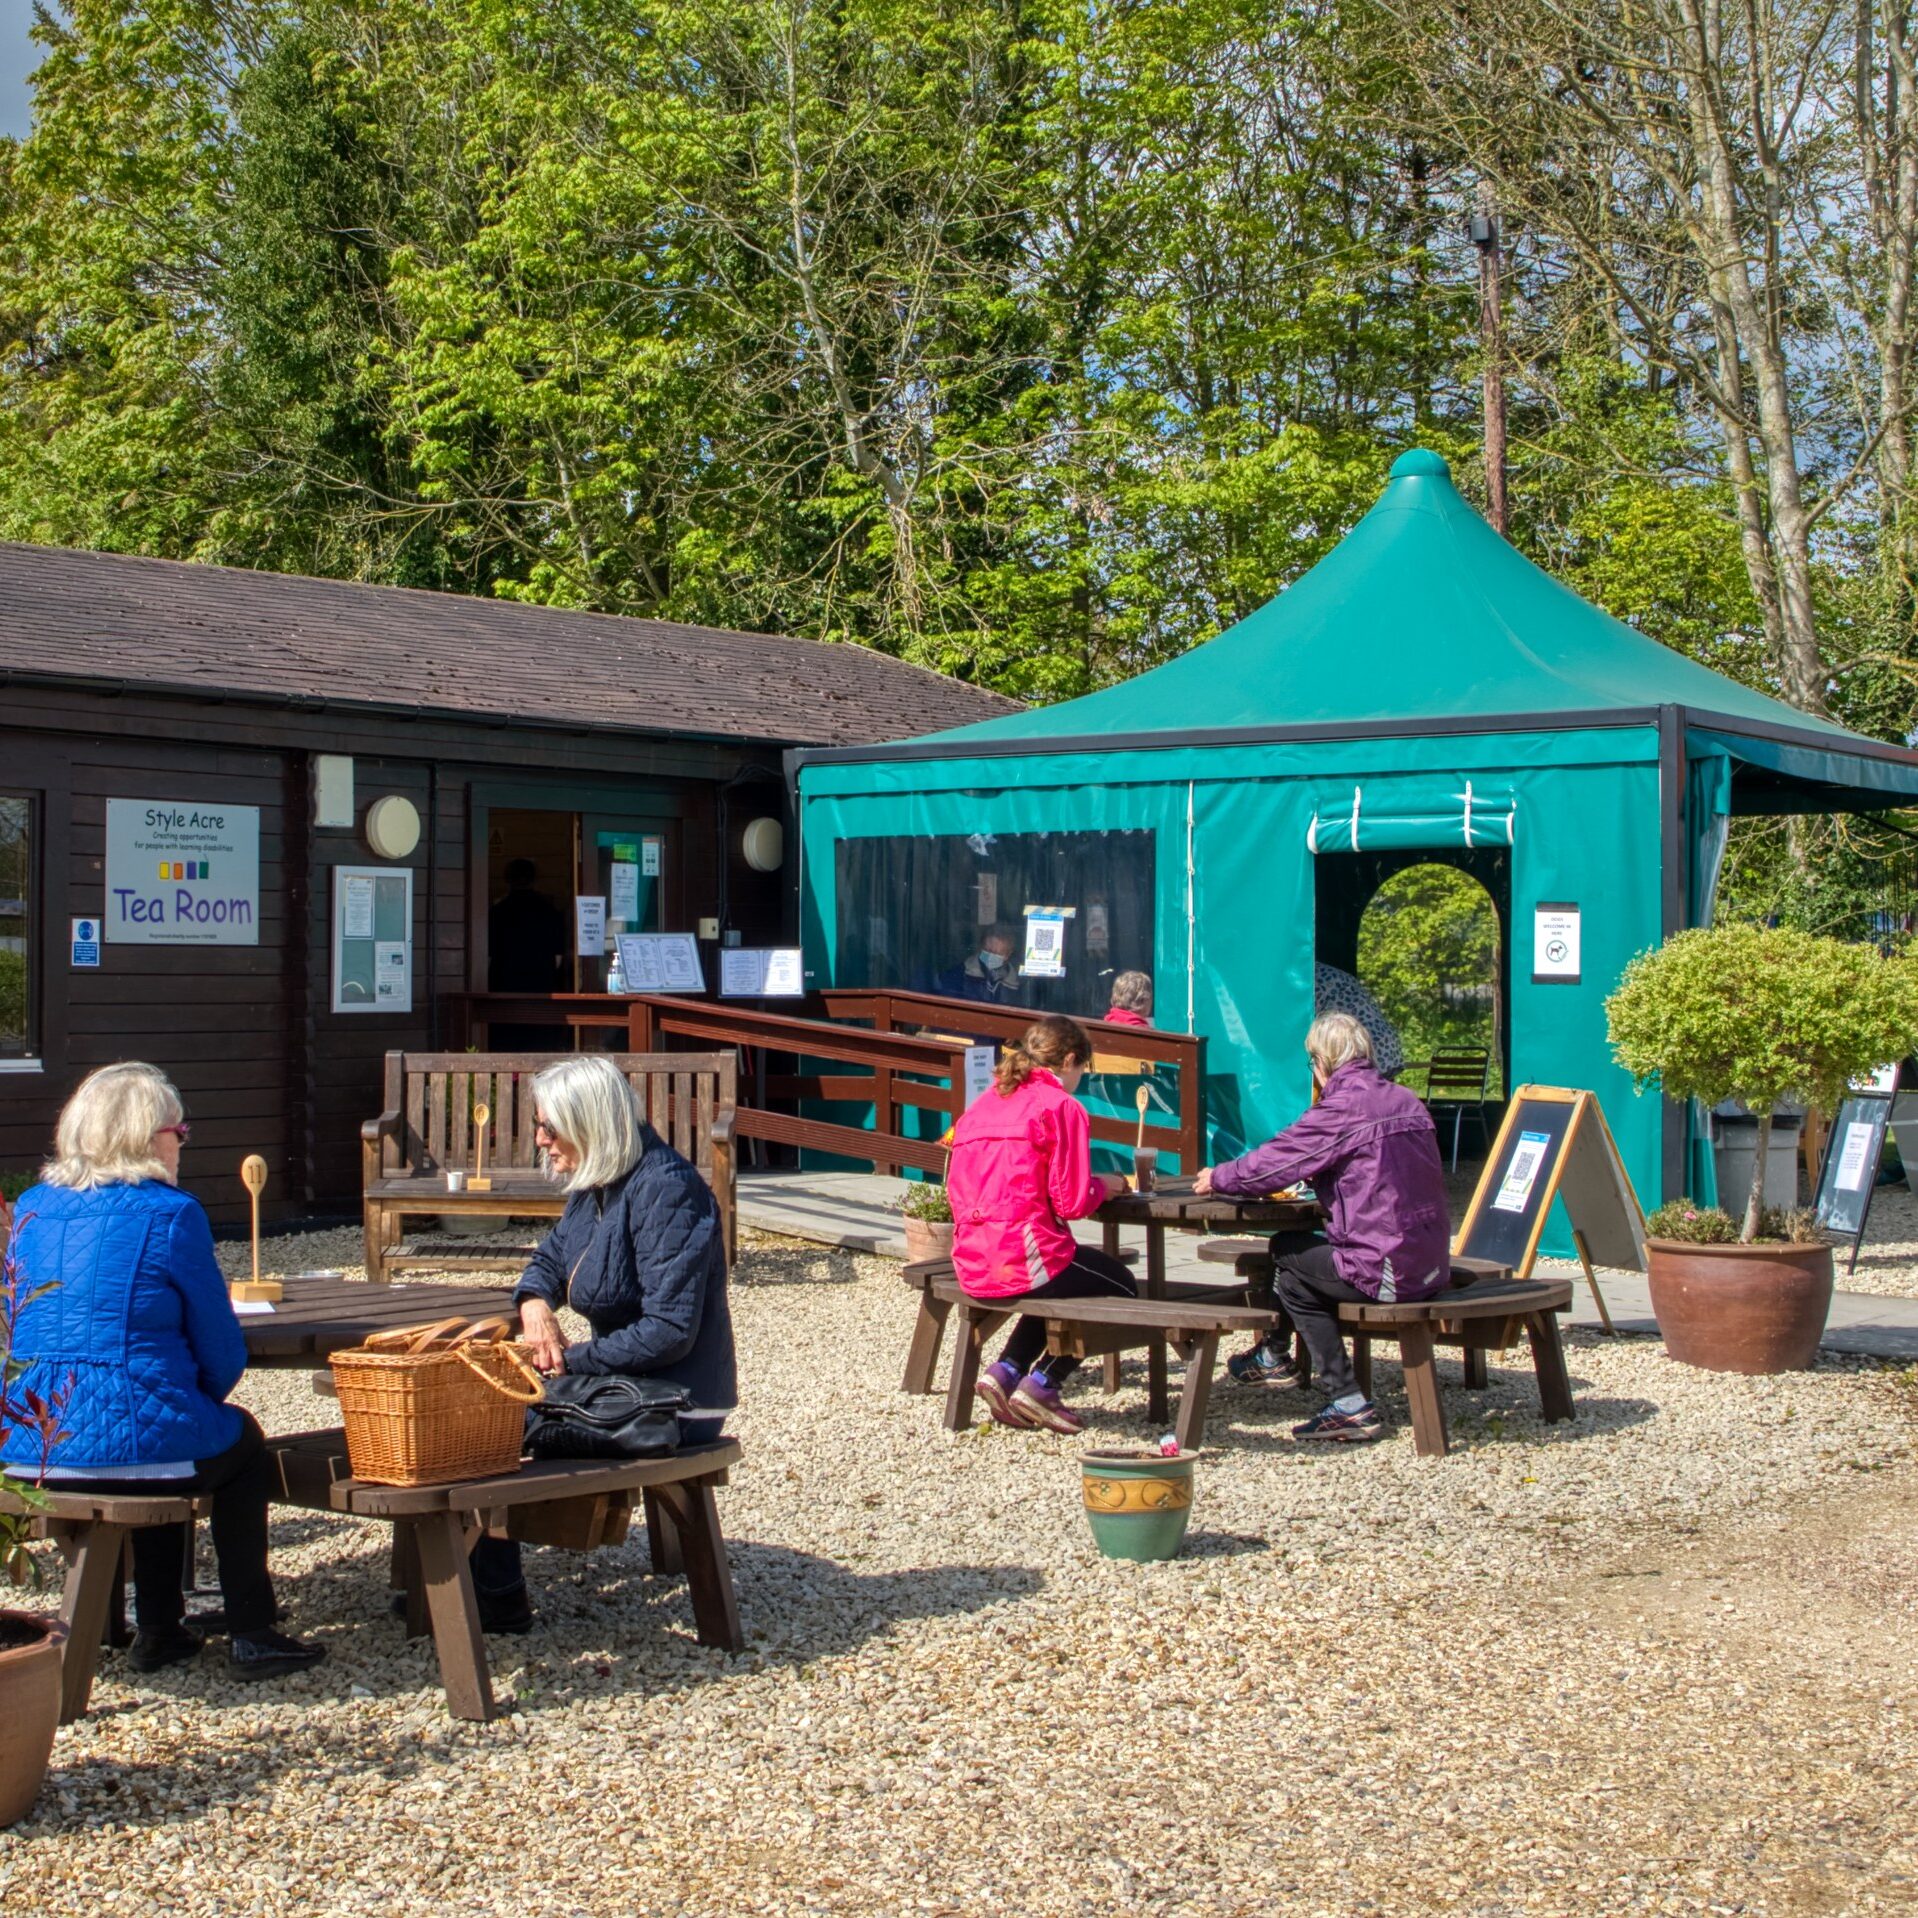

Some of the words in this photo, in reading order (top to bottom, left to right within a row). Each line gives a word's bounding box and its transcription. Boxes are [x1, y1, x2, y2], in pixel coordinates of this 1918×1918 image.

[145, 809, 185, 832] Style
[189, 811, 225, 829] Acre
[134, 841, 145, 849] for
[145, 842, 164, 850] people
[165, 842, 179, 850] with
[179, 843, 202, 853] learning
[203, 844, 234, 853] disabilities
[153, 832, 178, 842] Creating
[179, 833, 218, 843] opportunities
[113, 889, 165, 923] Tea
[176, 888, 252, 924] Room
[248, 1164, 263, 1183] 11
